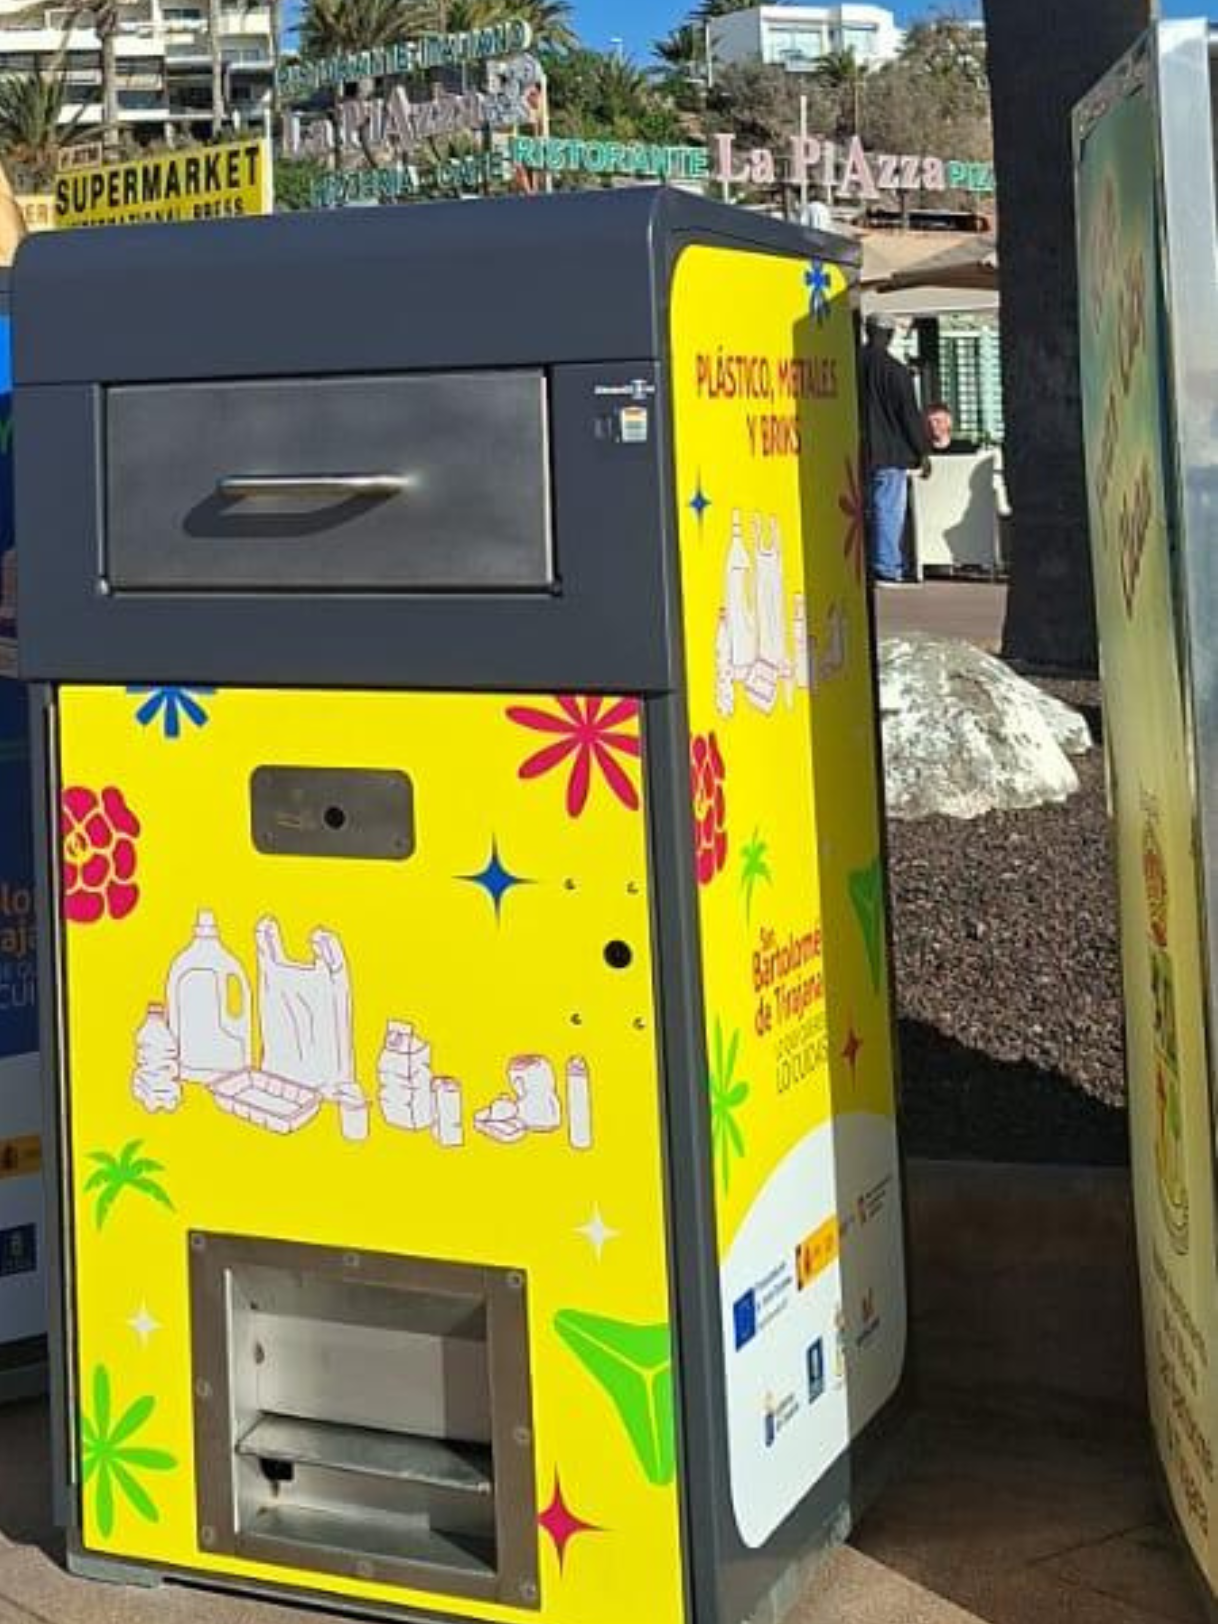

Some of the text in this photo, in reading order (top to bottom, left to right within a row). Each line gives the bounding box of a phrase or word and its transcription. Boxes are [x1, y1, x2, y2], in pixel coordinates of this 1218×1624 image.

[55, 146, 260, 216] SUPERMARKET
[514, 136, 710, 179] RISTORANTE
[713, 133, 776, 183] La
[694, 345, 775, 405] PLÁSTICO,
